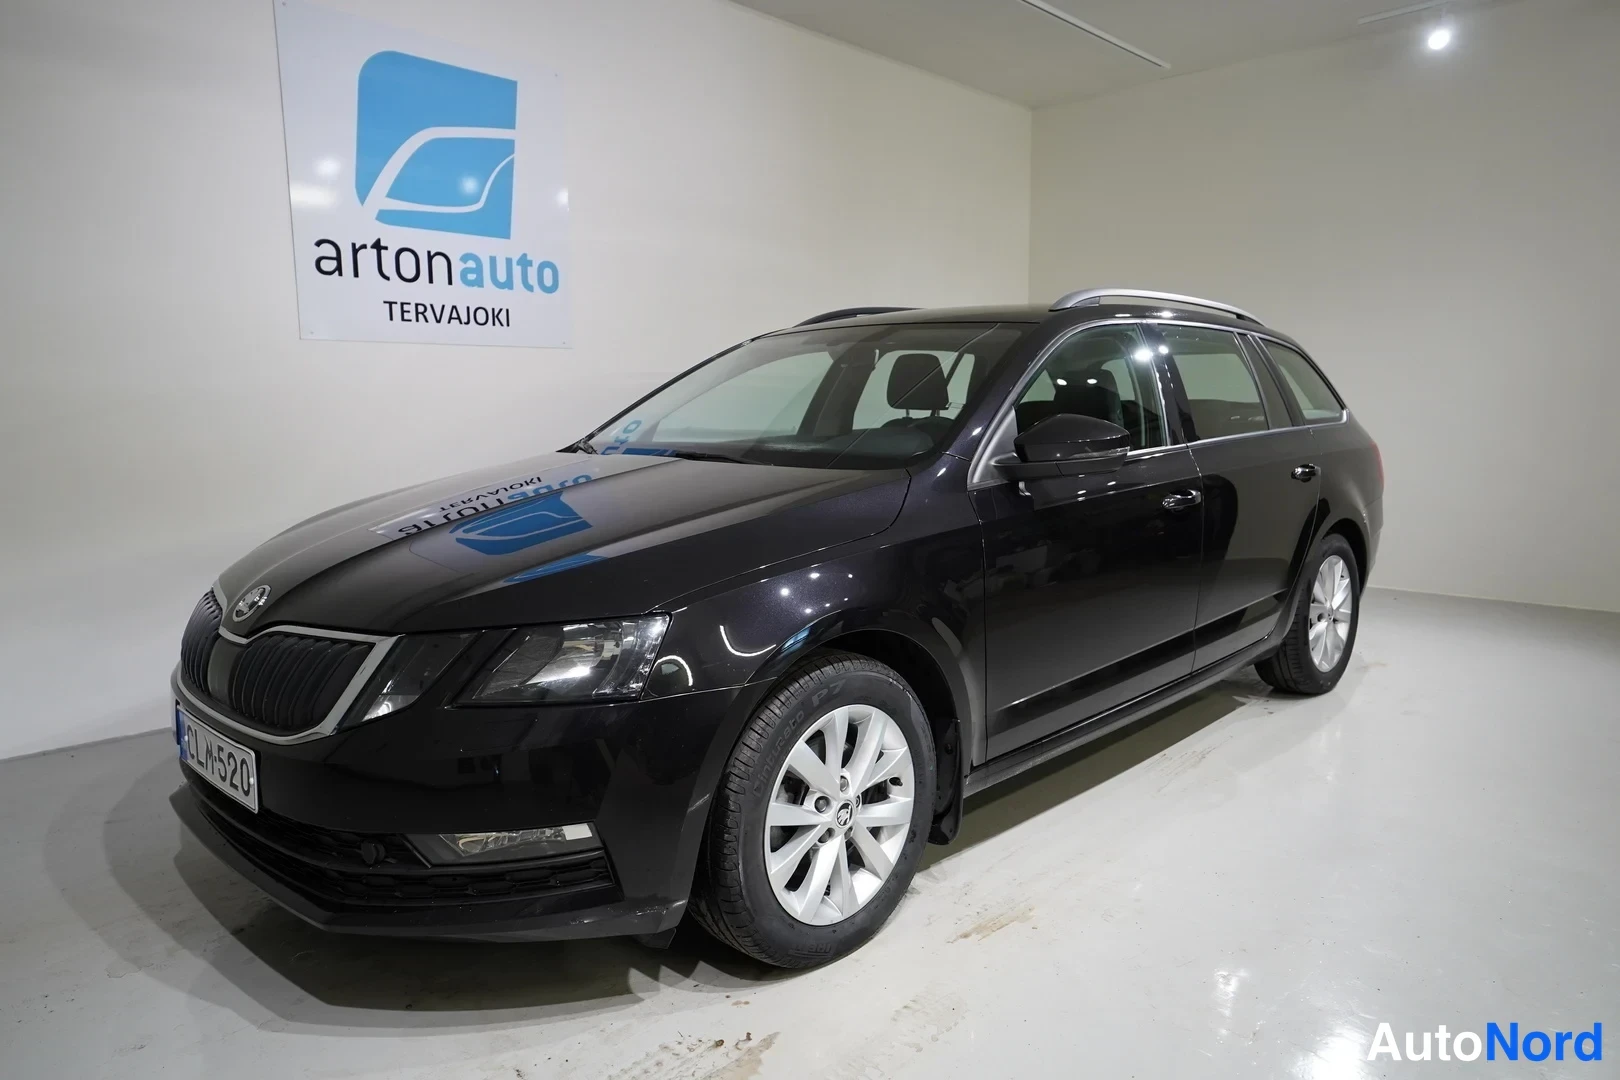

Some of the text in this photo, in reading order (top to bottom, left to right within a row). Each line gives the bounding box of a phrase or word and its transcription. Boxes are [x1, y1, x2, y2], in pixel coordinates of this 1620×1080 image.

[383, 300, 511, 328] TERVAJOKI
[811, 679, 847, 708] P7
[187, 724, 251, 797] CLM-520
